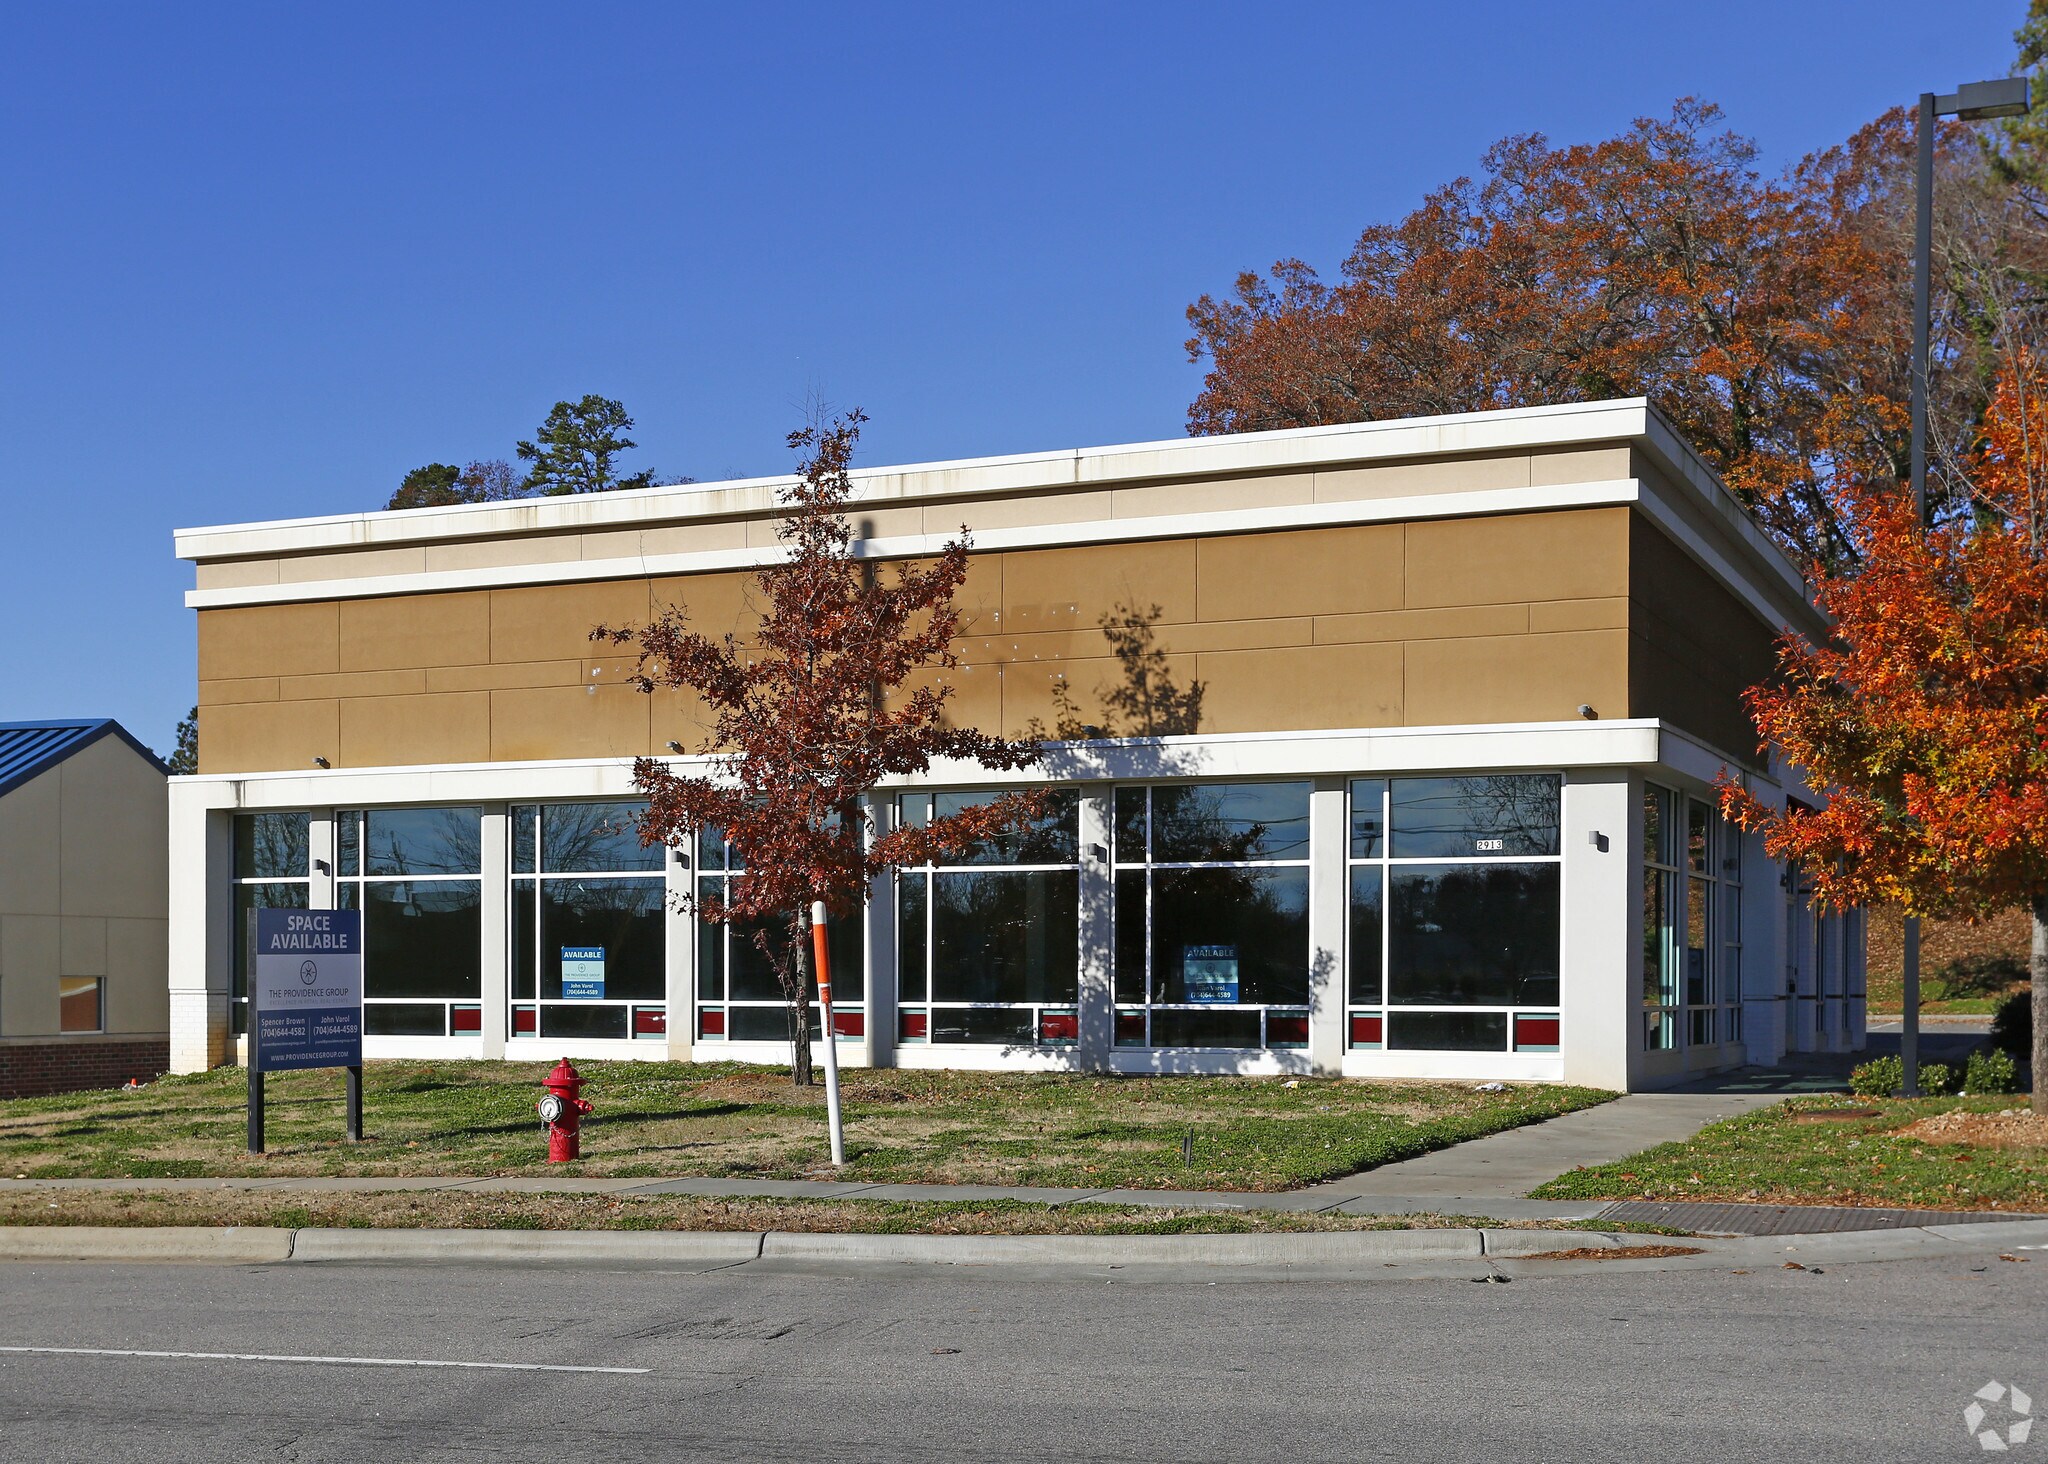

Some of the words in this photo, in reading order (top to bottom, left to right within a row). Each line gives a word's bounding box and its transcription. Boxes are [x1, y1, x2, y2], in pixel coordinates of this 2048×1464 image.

[1478, 841, 1502, 849] 2913
[287, 915, 330, 931] SPACE
[270, 933, 348, 949] AVAILABLE
[1188, 949, 1234, 957] AVAILABLE
[269, 989, 281, 998] THE
[283, 988, 324, 998] PROVIDENCE
[325, 988, 349, 996] GROUP
[261, 1018, 284, 1027] Spencer
[286, 1017, 305, 1025] Brown
[261, 1027, 306, 1038] (704)644-4582
[313, 1025, 358, 1036] (704)644-4589
[271, 1051, 349, 1061] WWW.PROVIDENCEGROUP.COM
